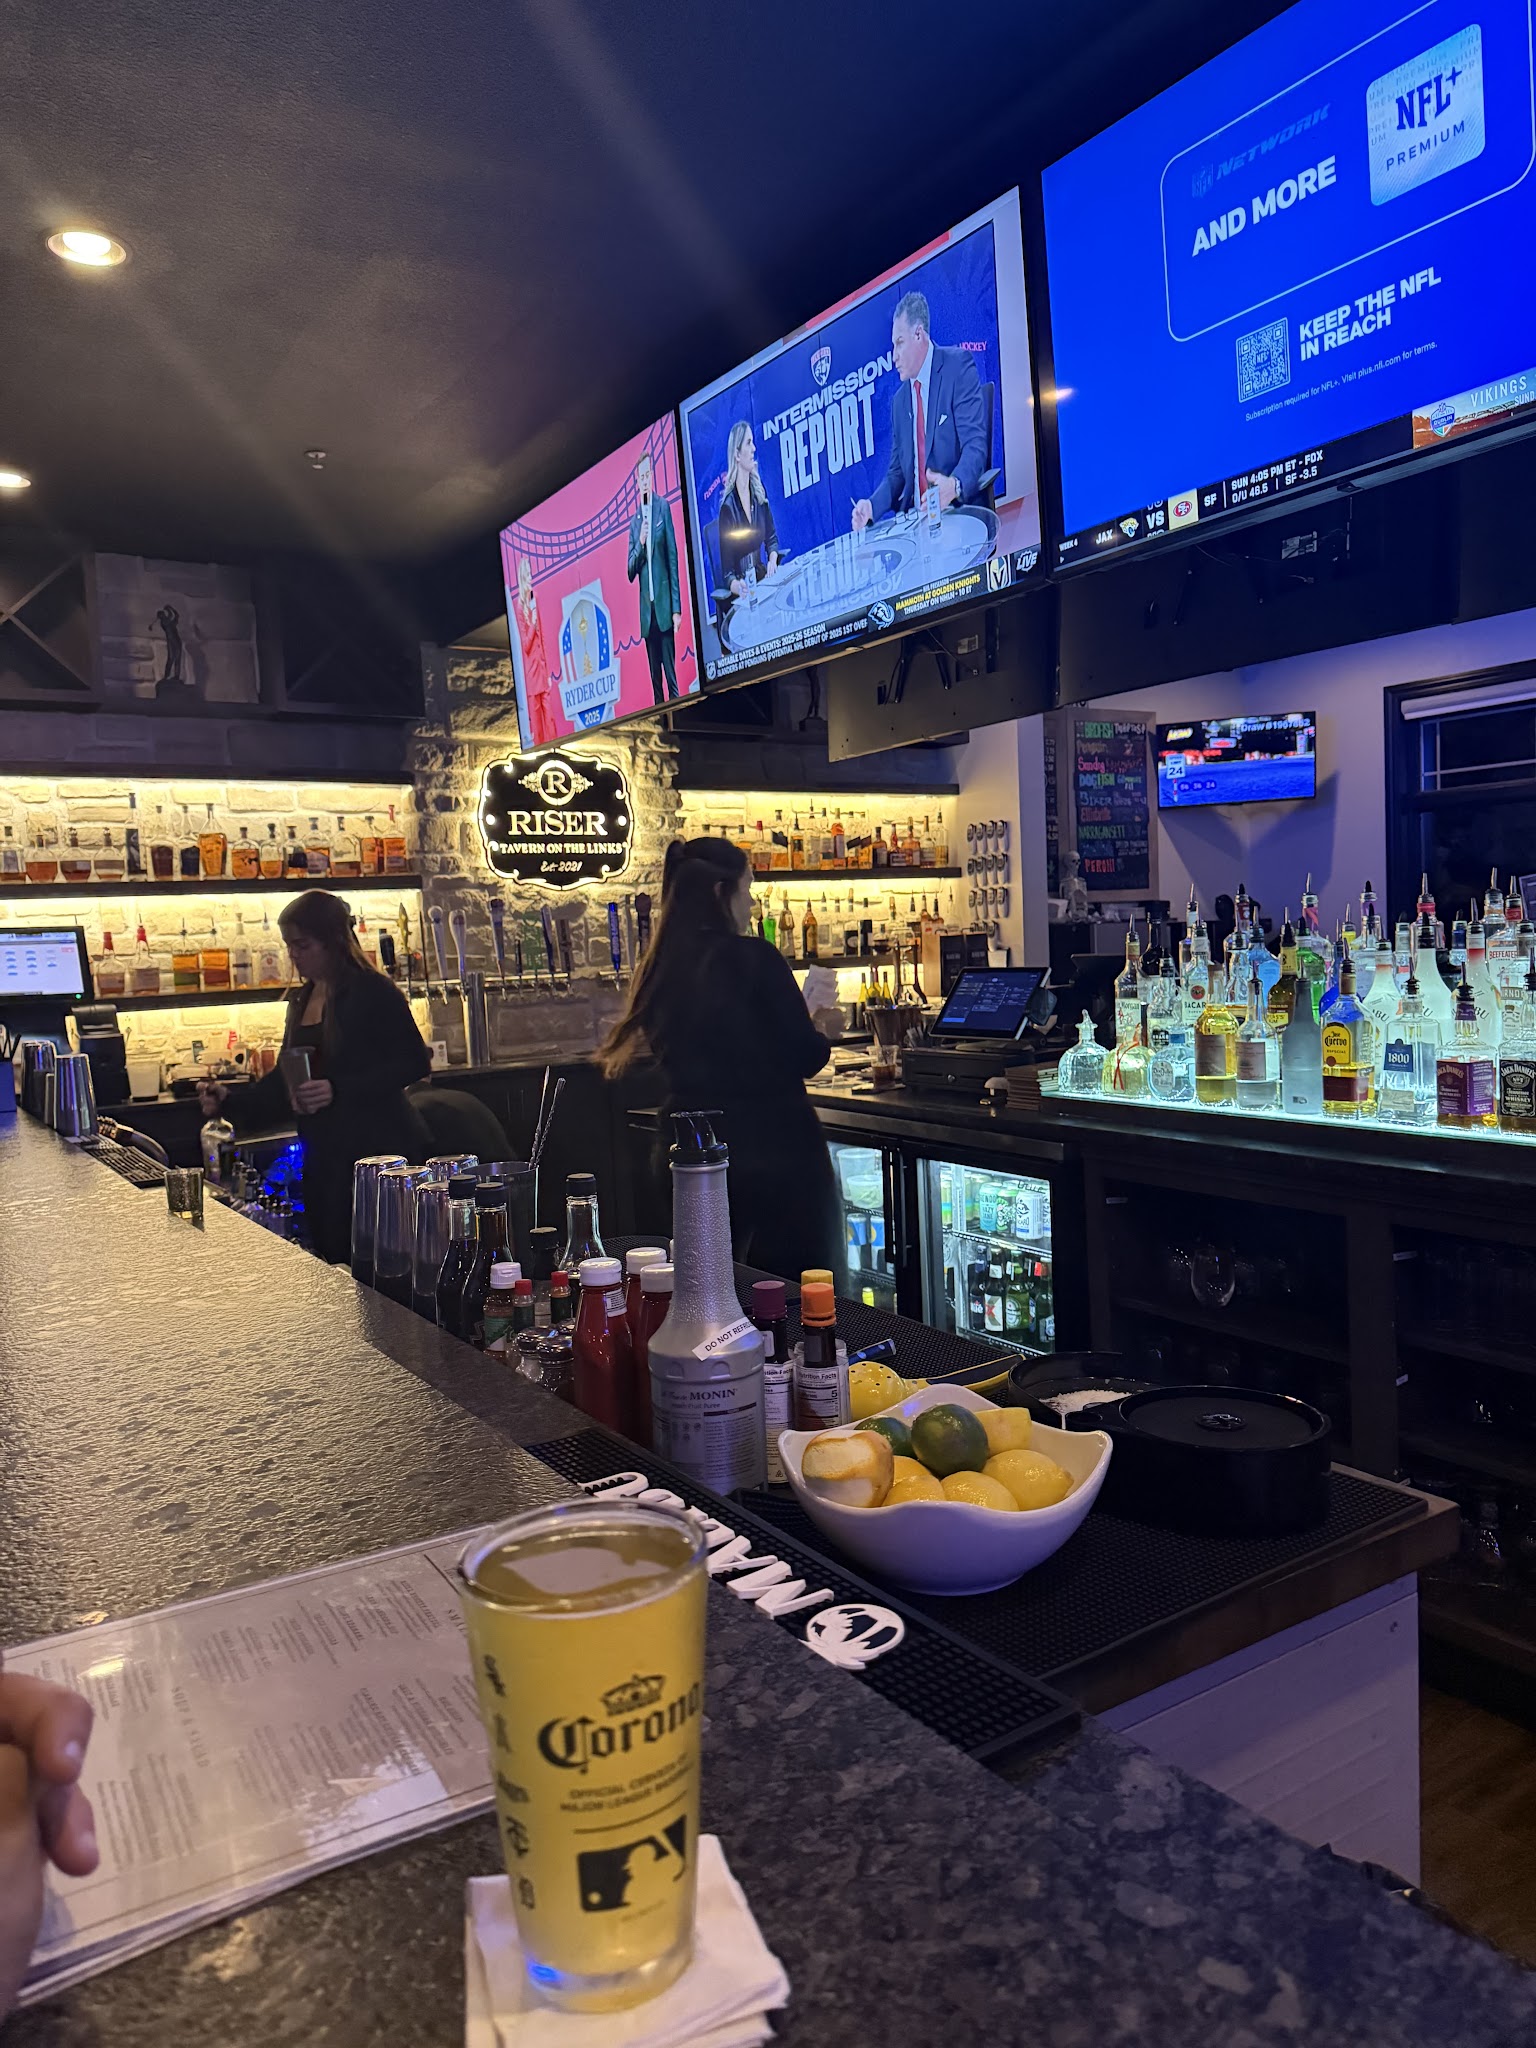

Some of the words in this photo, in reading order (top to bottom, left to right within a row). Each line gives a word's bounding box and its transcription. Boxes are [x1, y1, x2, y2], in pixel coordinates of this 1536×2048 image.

[1216, 103, 1331, 180] NETWORK
[1387, 120, 1464, 171] PREMIUM
[1192, 207, 1246, 257] AND
[1252, 155, 1336, 224] MORE
[1300, 305, 1350, 342] KEEP
[1355, 284, 1396, 317] THE
[1400, 266, 1441, 298] NFL
[1301, 338, 1319, 361] IN
[1324, 307, 1391, 352] REACH
[1246, 401, 1283, 422] Subscription
[1284, 390, 1310, 408] required
[1311, 386, 1320, 396] for
[1342, 372, 1357, 384] Visit
[1358, 355, 1401, 379] plus.nfl.com
[1402, 350, 1412, 360] for
[1414, 342, 1438, 356] terms.
[1470, 376, 1527, 407] VIKINGS
[763, 351, 894, 441] INTERMISSION
[1514, 391, 1535, 406] SUND
[779, 383, 876, 499] REPORT
[1231, 476, 1248, 490] SUN
[1250, 471, 1269, 484] 4:05
[1270, 464, 1283, 477] PM
[1285, 459, 1297, 472] ET
[1305, 450, 1323, 465] FOX
[1285, 472, 1297, 485] SF
[1204, 493, 1217, 507] SF
[1146, 510, 1165, 529] VS
[1059, 540, 1073, 552] WEEK
[1095, 529, 1113, 544] JAX
[1016, 550, 1038, 571] LIVE
[895, 593, 924, 611] MAMMOTH
[924, 591, 932, 601] AT
[932, 583, 955, 599] GOLDEN
[955, 573, 981, 591] KNIGHTS
[903, 600, 931, 615] THURSDAY
[930, 597, 940, 607] ON
[717, 653, 740, 668] NOTABLE
[739, 648, 756, 663] DATES
[760, 641, 781, 656] EVENTS:
[803, 622, 827, 639] SEASON
[804, 634, 821, 649] DEBUT
[821, 631, 828, 642] OF
[829, 626, 843, 640] 2025
[843, 623, 853, 636] 1ST
[565, 681, 595, 708] RYDER
[595, 673, 616, 698] CUP
[584, 709, 600, 726] 2025
[1241, 722, 1266, 733] Draw
[1168, 766, 1183, 776] 24
[544, 771, 569, 793] R
[507, 810, 608, 836] RISER
[500, 843, 545, 854] TAVERN
[547, 843, 563, 854] ON
[563, 843, 585, 854] THE
[588, 842, 623, 854] LINKS
[558, 861, 583, 872] 2021
[1489, 950, 1518, 959] BEEFEATER
[1184, 1001, 1207, 1009] BACAR
[1324, 1037, 1347, 1047] Cuervo
[1388, 1052, 1409, 1064] 1800
[1501, 1067, 1514, 1076] JACK
[704, 1341, 718, 1352] DO
[717, 1331, 733, 1344] NOT
[689, 1388, 736, 1401] MONIN
[831, 1389, 838, 1398] 5
